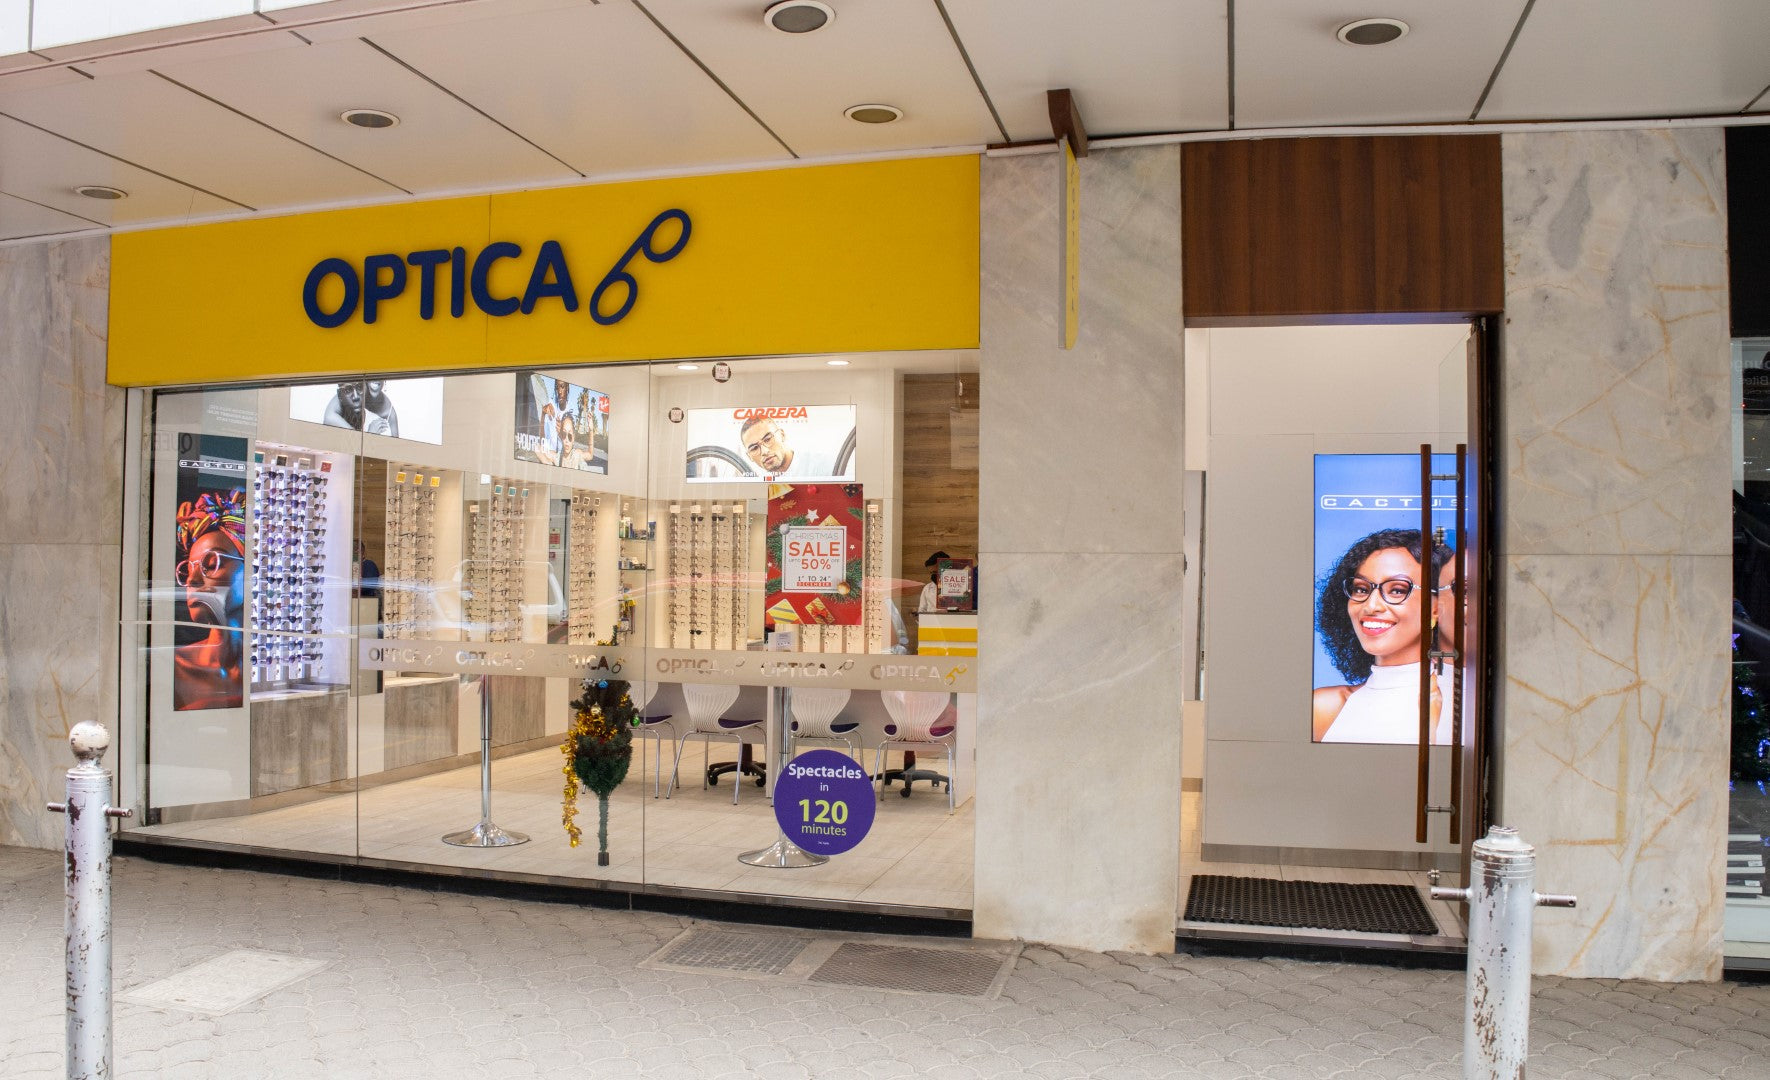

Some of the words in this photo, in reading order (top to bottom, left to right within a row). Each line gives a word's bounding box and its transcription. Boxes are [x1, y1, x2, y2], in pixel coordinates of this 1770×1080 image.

[303, 240, 579, 328] OPTICA
[733, 407, 807, 420] CARRERA
[788, 541, 841, 557] SALE
[801, 558, 832, 570] 50%
[943, 575, 967, 583] SALE
[656, 657, 720, 675] OPTICA
[760, 660, 829, 677] OPTICA
[869, 663, 941, 682] OPTICA
[788, 763, 862, 779] Spectacles
[820, 782, 829, 791] in
[799, 799, 848, 824] 120
[801, 823, 847, 836] minutes
